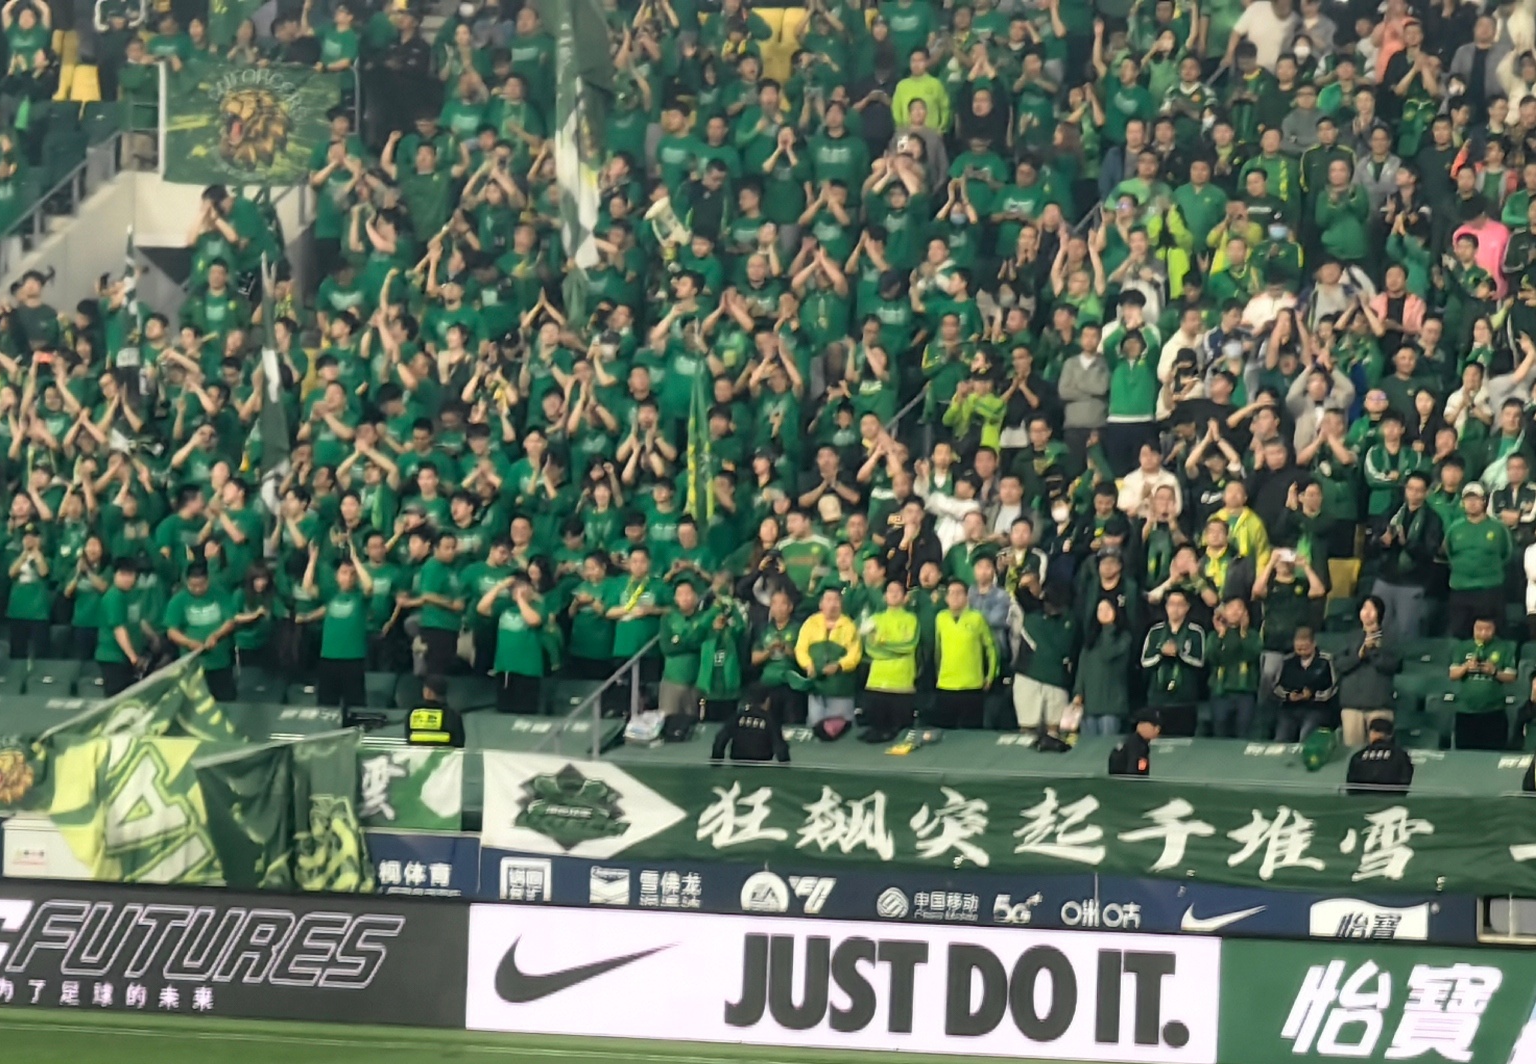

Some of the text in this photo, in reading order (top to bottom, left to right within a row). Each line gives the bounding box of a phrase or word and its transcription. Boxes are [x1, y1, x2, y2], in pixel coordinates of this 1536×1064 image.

[5, 901, 406, 989] FUTURES
[913, 891, 980, 913] 中国移动
[723, 931, 1192, 1049] JUST DO IT.
[1279, 957, 1504, 1064] 怡寶
